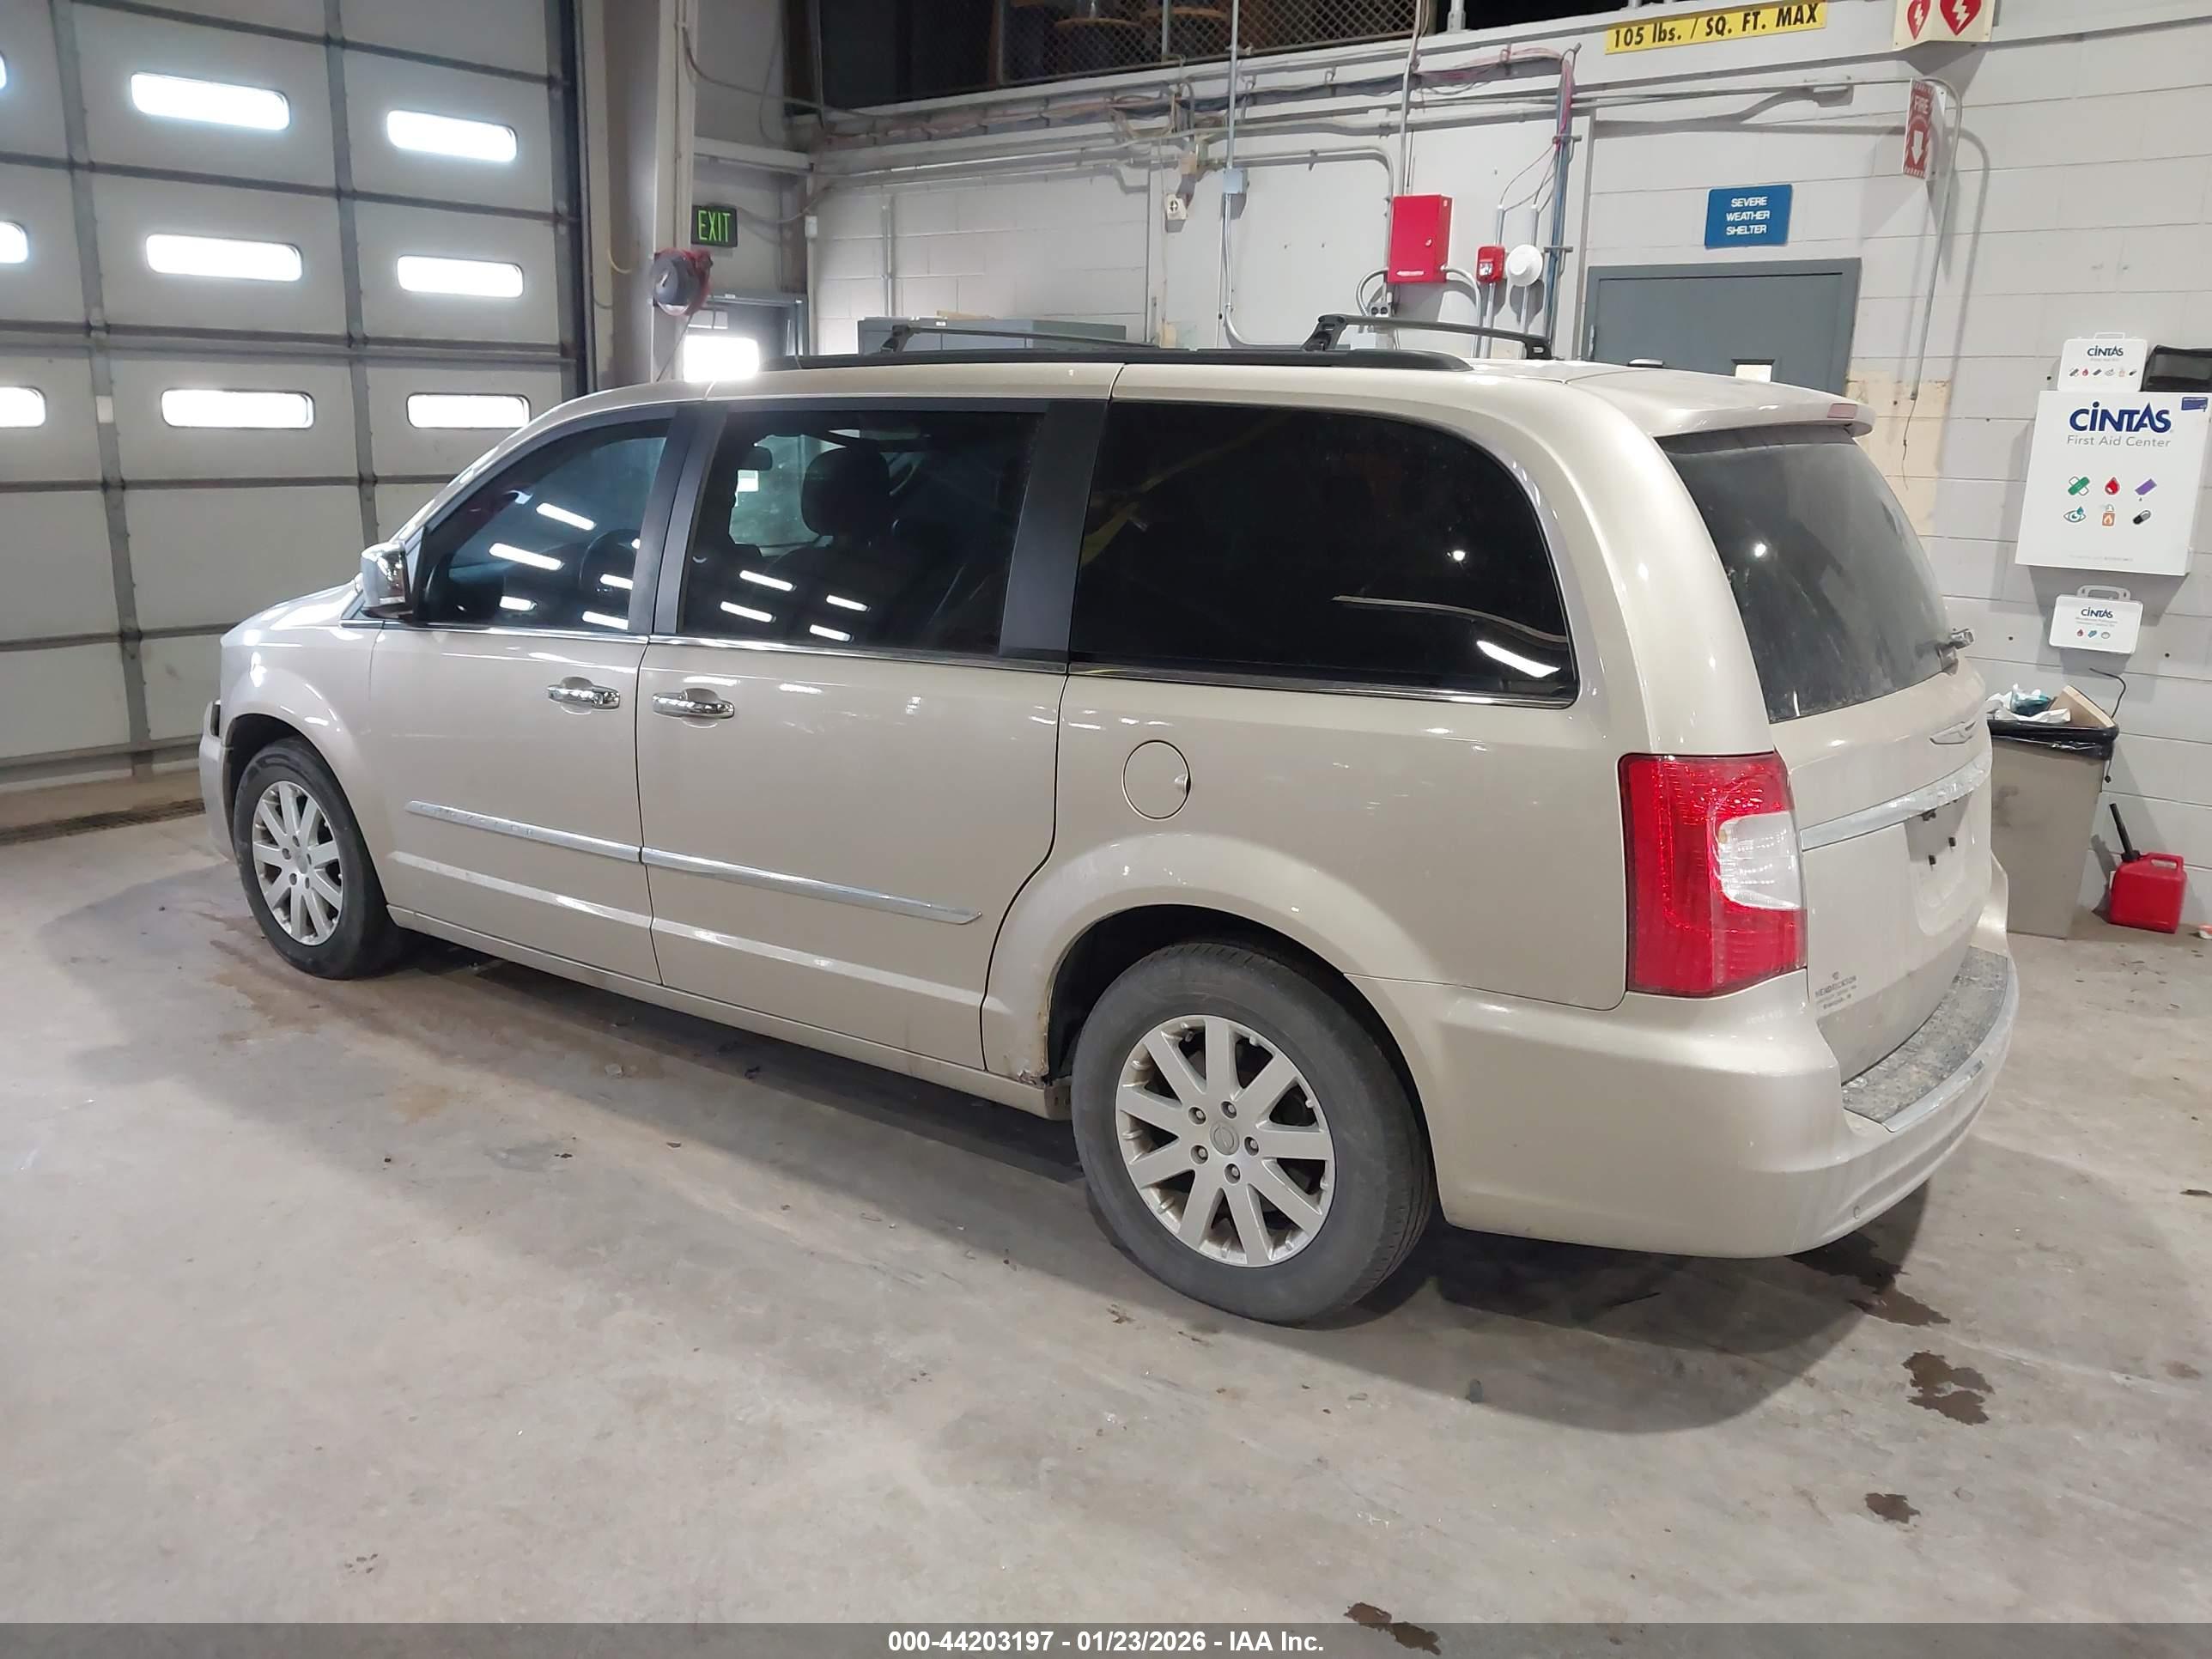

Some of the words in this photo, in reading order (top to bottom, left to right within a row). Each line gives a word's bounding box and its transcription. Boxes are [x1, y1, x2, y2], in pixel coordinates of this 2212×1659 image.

[1614, 27, 1644, 48] 105
[1651, 22, 1682, 43] lbs.
[1690, 17, 1698, 40] /
[1705, 15, 1733, 37] SQ.
[1741, 11, 1766, 32] FT.
[1775, 3, 1819, 27] MAX
[1730, 196, 1768, 208] SEVERE
[1726, 210, 1771, 222] WEATHER
[697, 210, 731, 243] EXIT
[1726, 224, 1767, 235] SHELTER
[2067, 434, 2095, 446] First
[2099, 435, 2122, 447] Aid
[2125, 436, 2172, 447] Center
